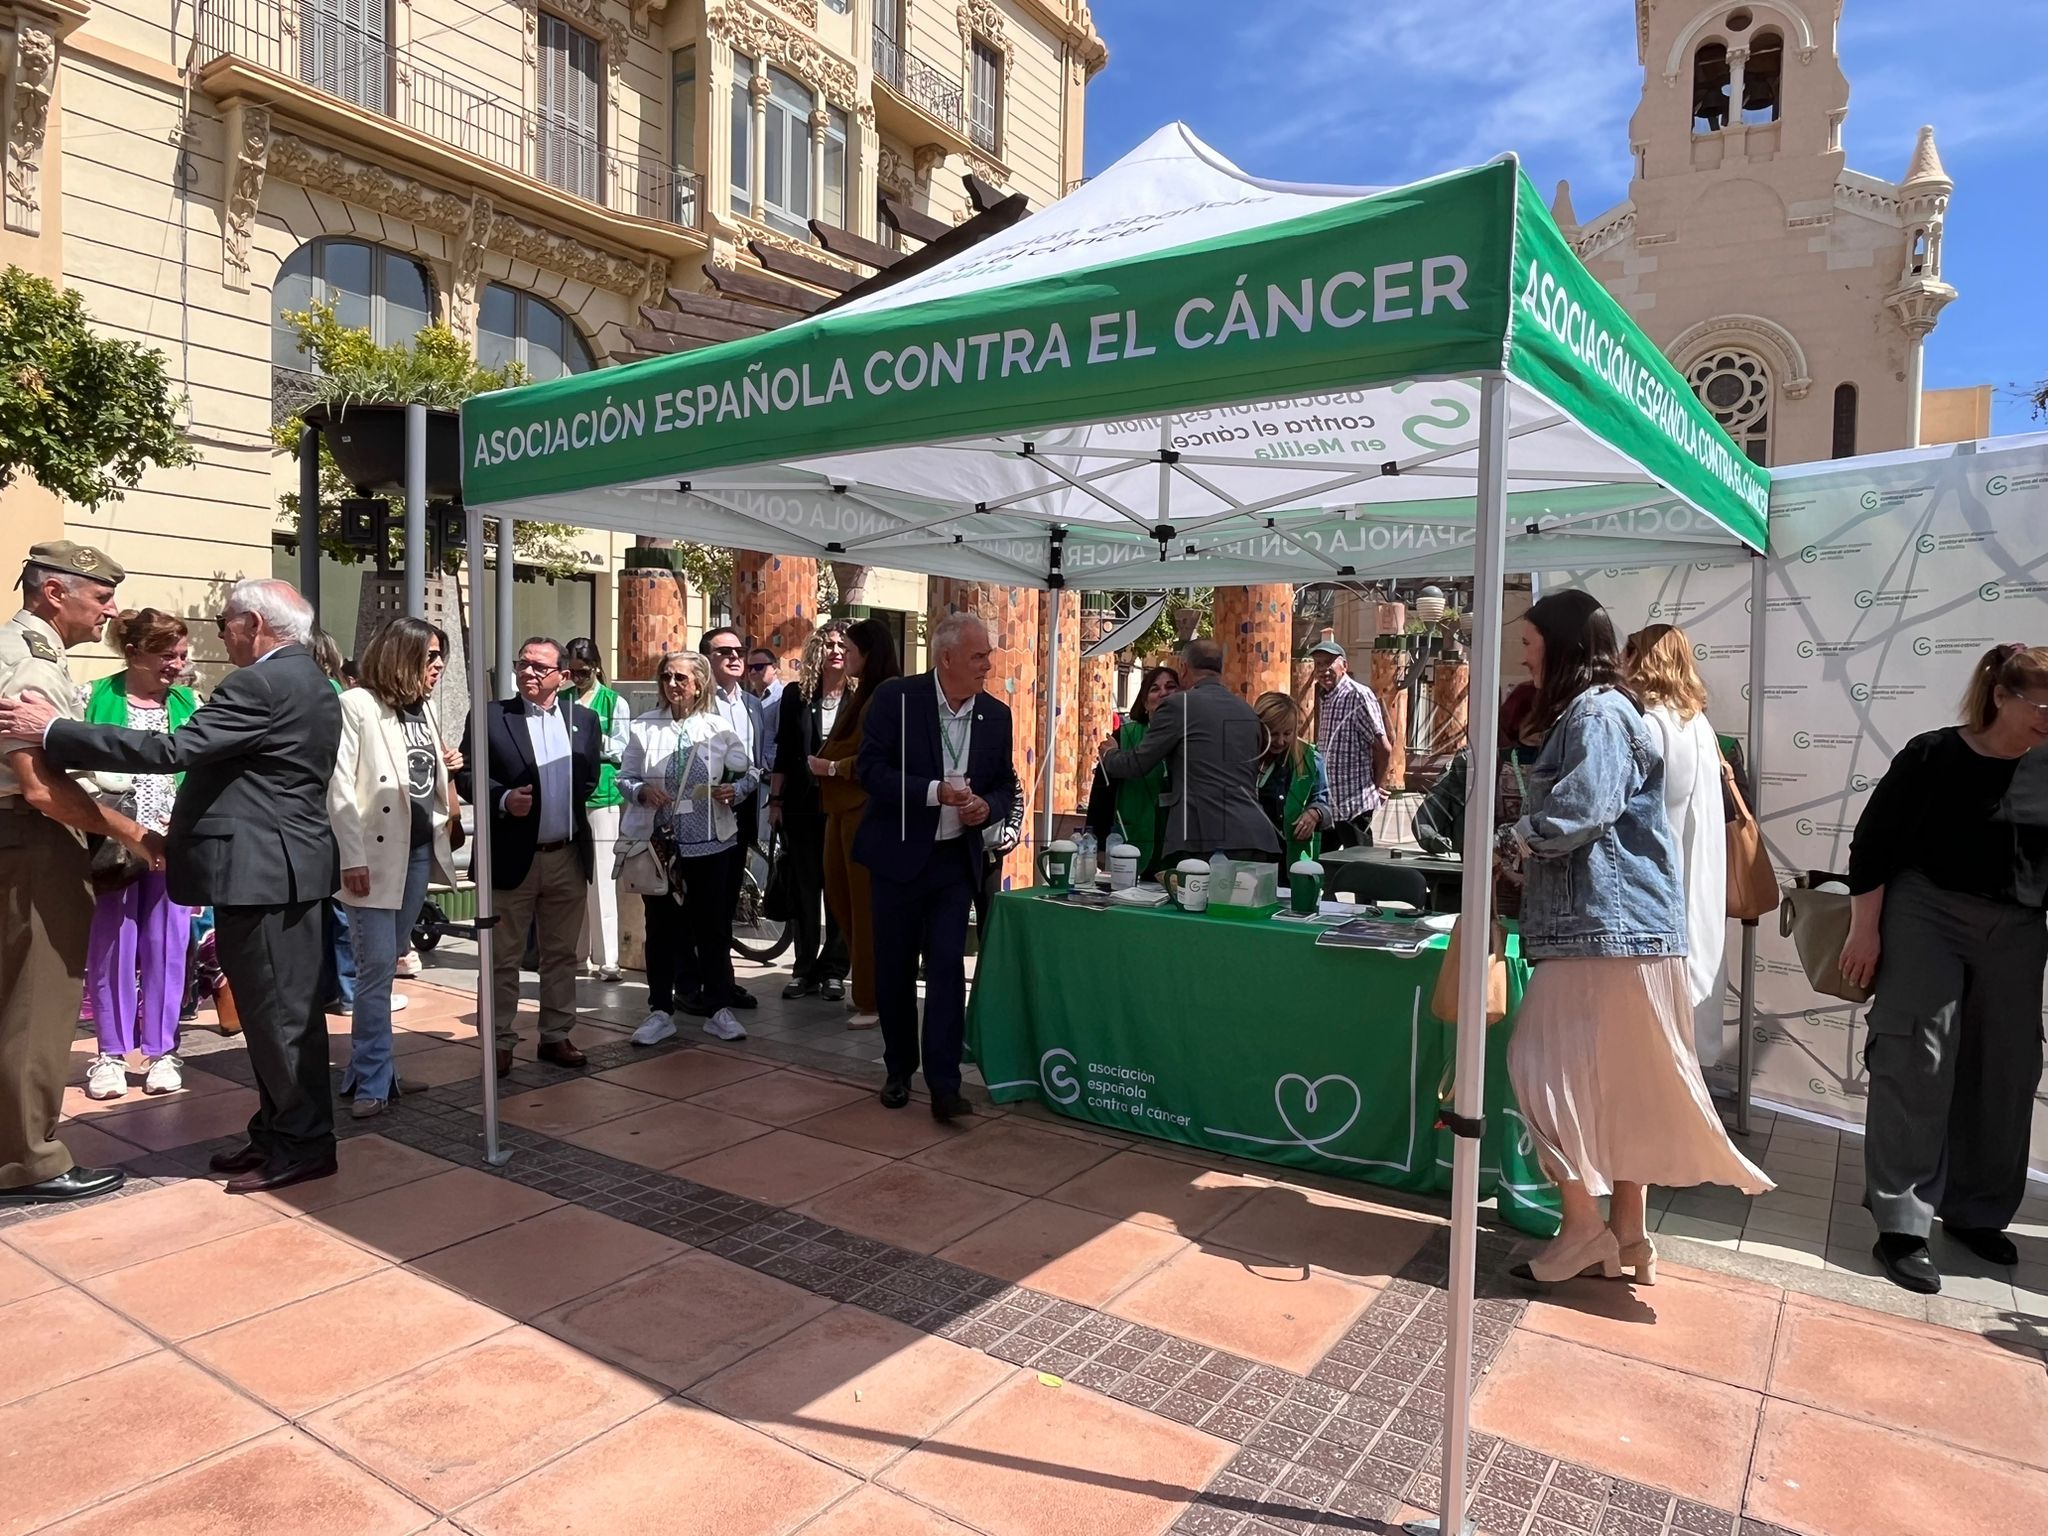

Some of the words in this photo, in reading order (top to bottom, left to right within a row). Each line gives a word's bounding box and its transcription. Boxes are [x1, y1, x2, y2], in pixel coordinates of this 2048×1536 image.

[474, 395, 646, 468] ASOCIACIÓN
[654, 356, 854, 434] ESPAÑOLA
[863, 322, 1071, 397] CONTRA
[1087, 309, 1157, 365] EL
[1174, 254, 1470, 351] CÁNCER
[1521, 258, 1636, 407] ASOCIACIÓN
[1635, 366, 1699, 461] ESPAÑOLA
[1697, 427, 1735, 491] CONTRA
[1087, 1079, 1147, 1099] española
[1088, 1062, 1156, 1085] asociación
[1087, 1096, 1128, 1112] contra
[1131, 1103, 1144, 1116] el
[1146, 1107, 1191, 1127] cáncer
